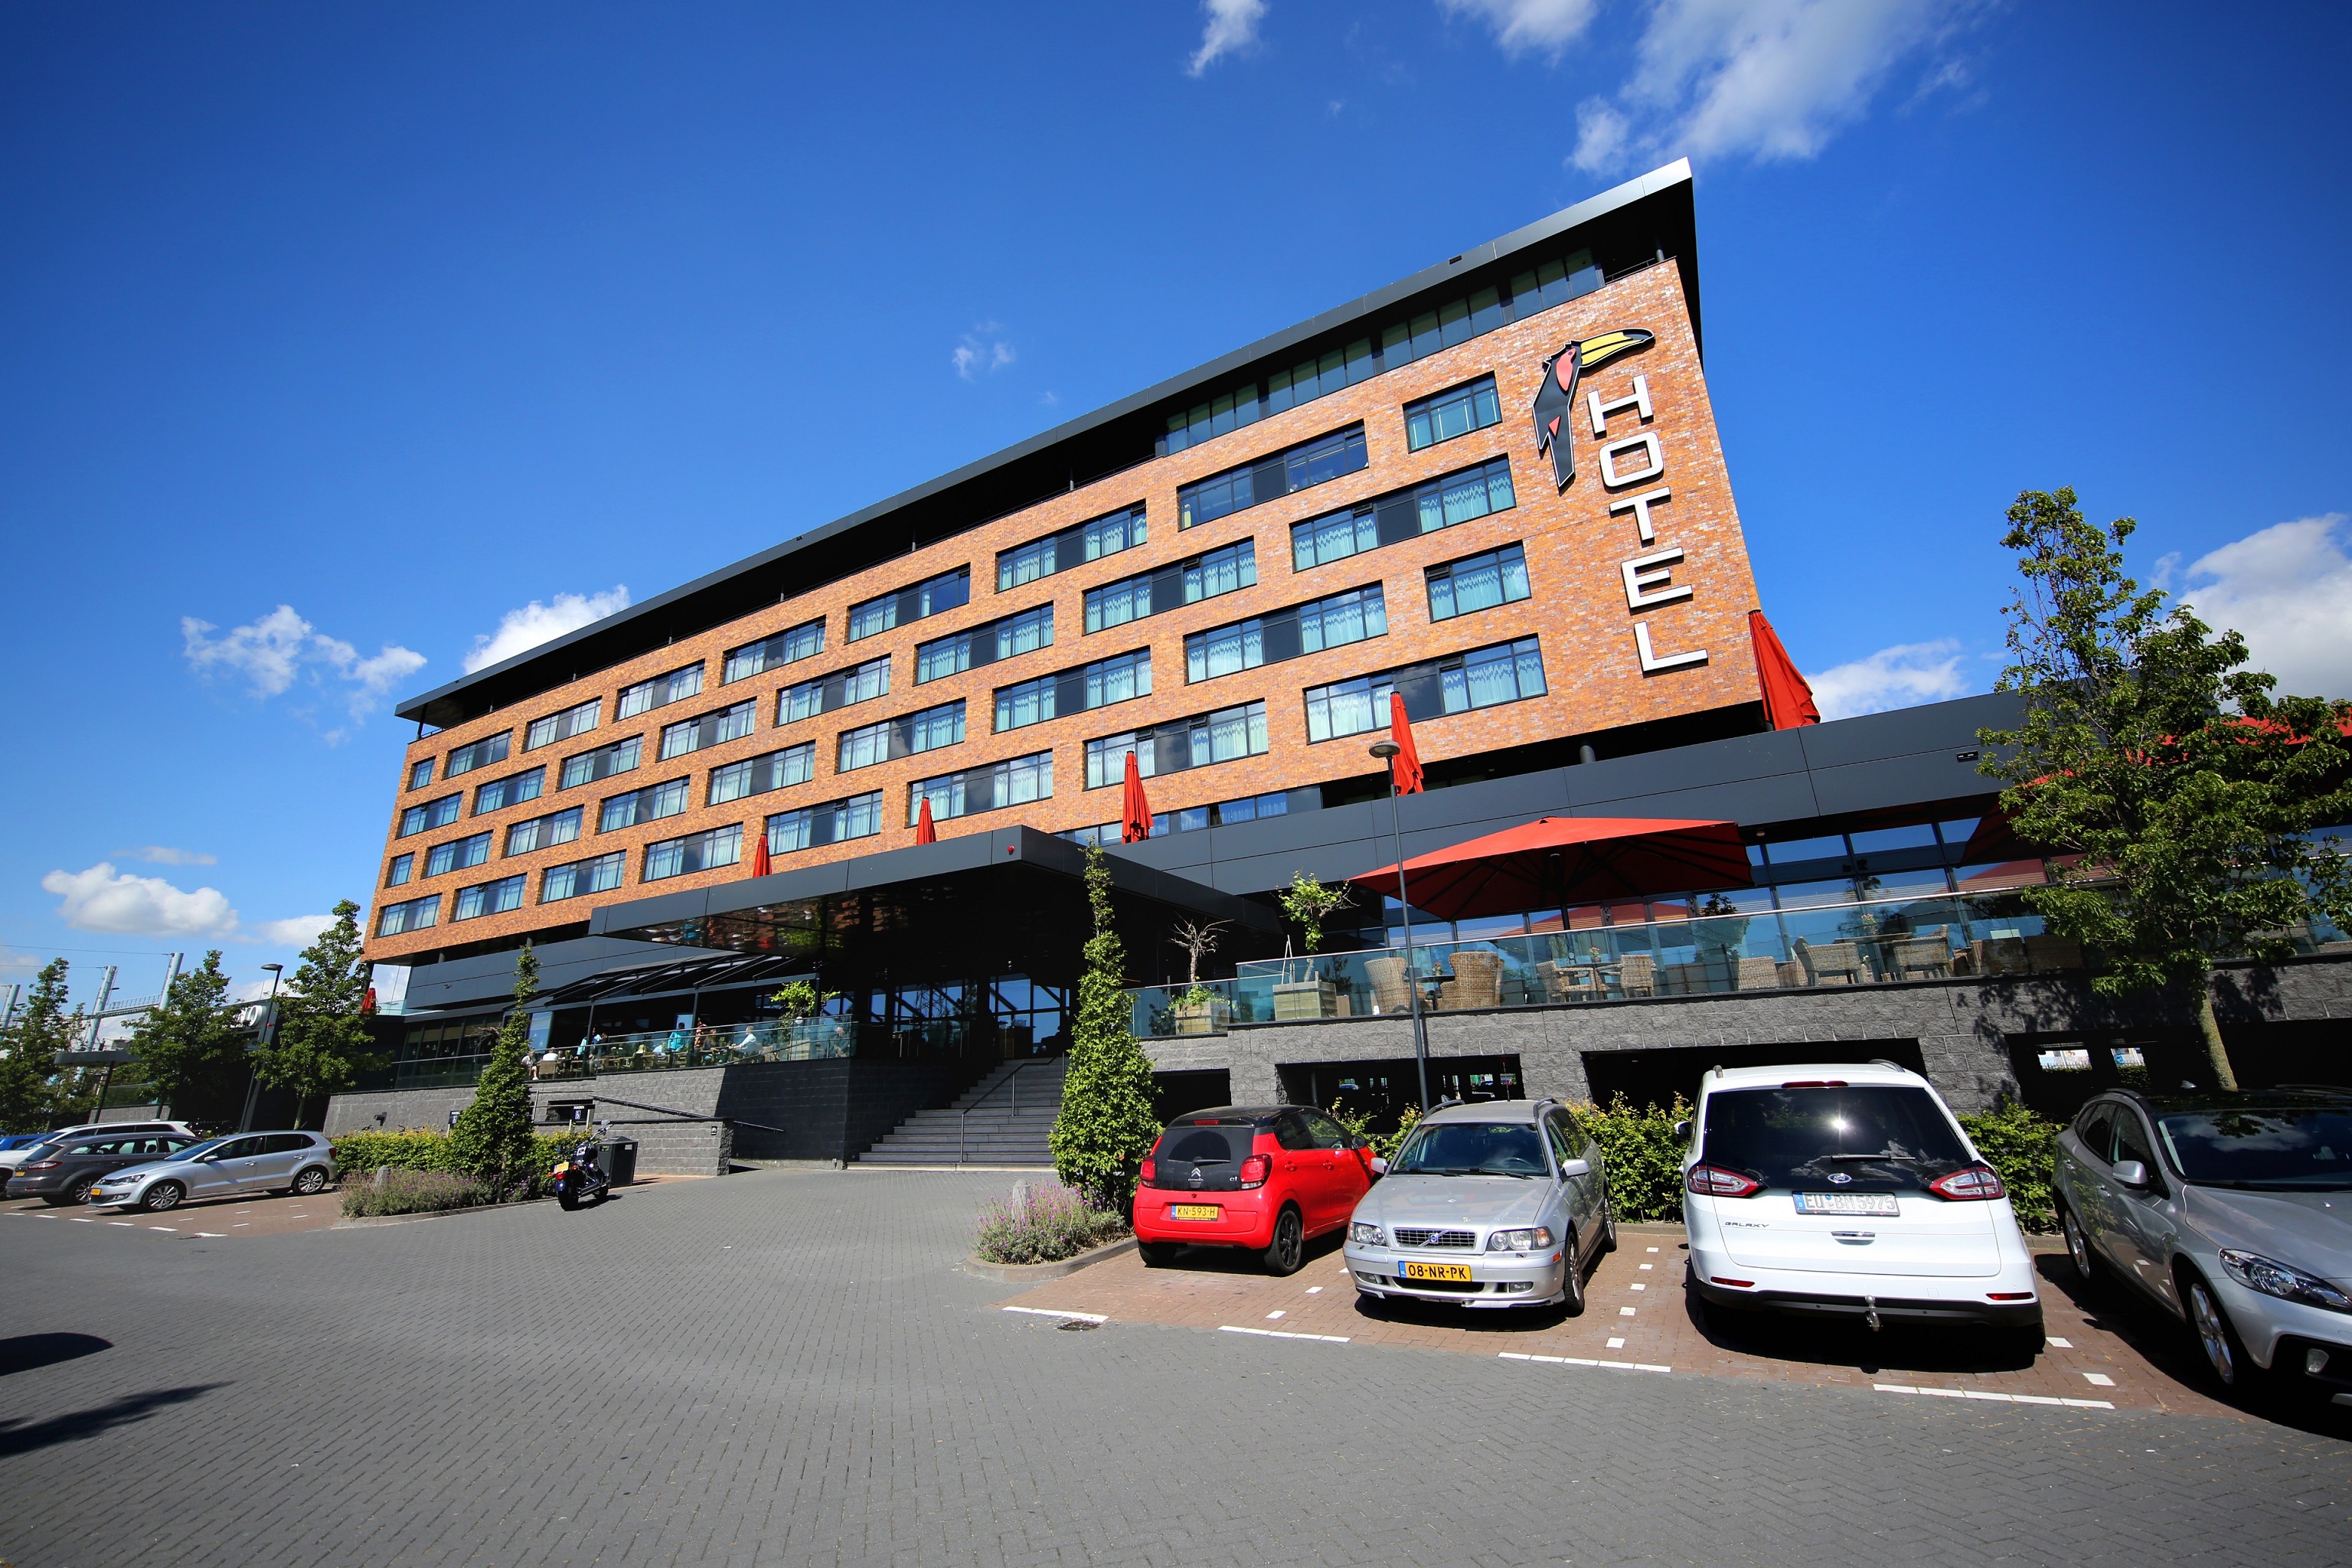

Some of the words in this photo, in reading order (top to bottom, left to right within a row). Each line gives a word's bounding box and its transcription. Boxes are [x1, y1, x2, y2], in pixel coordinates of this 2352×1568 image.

[1586, 373, 1708, 675] HOTEL
[1805, 1194, 1825, 1209] EU
[1855, 1194, 1896, 1210] 5975
[1178, 1207, 1216, 1217] KN-593-H
[1409, 1264, 1467, 1279] 08-NR-PK
